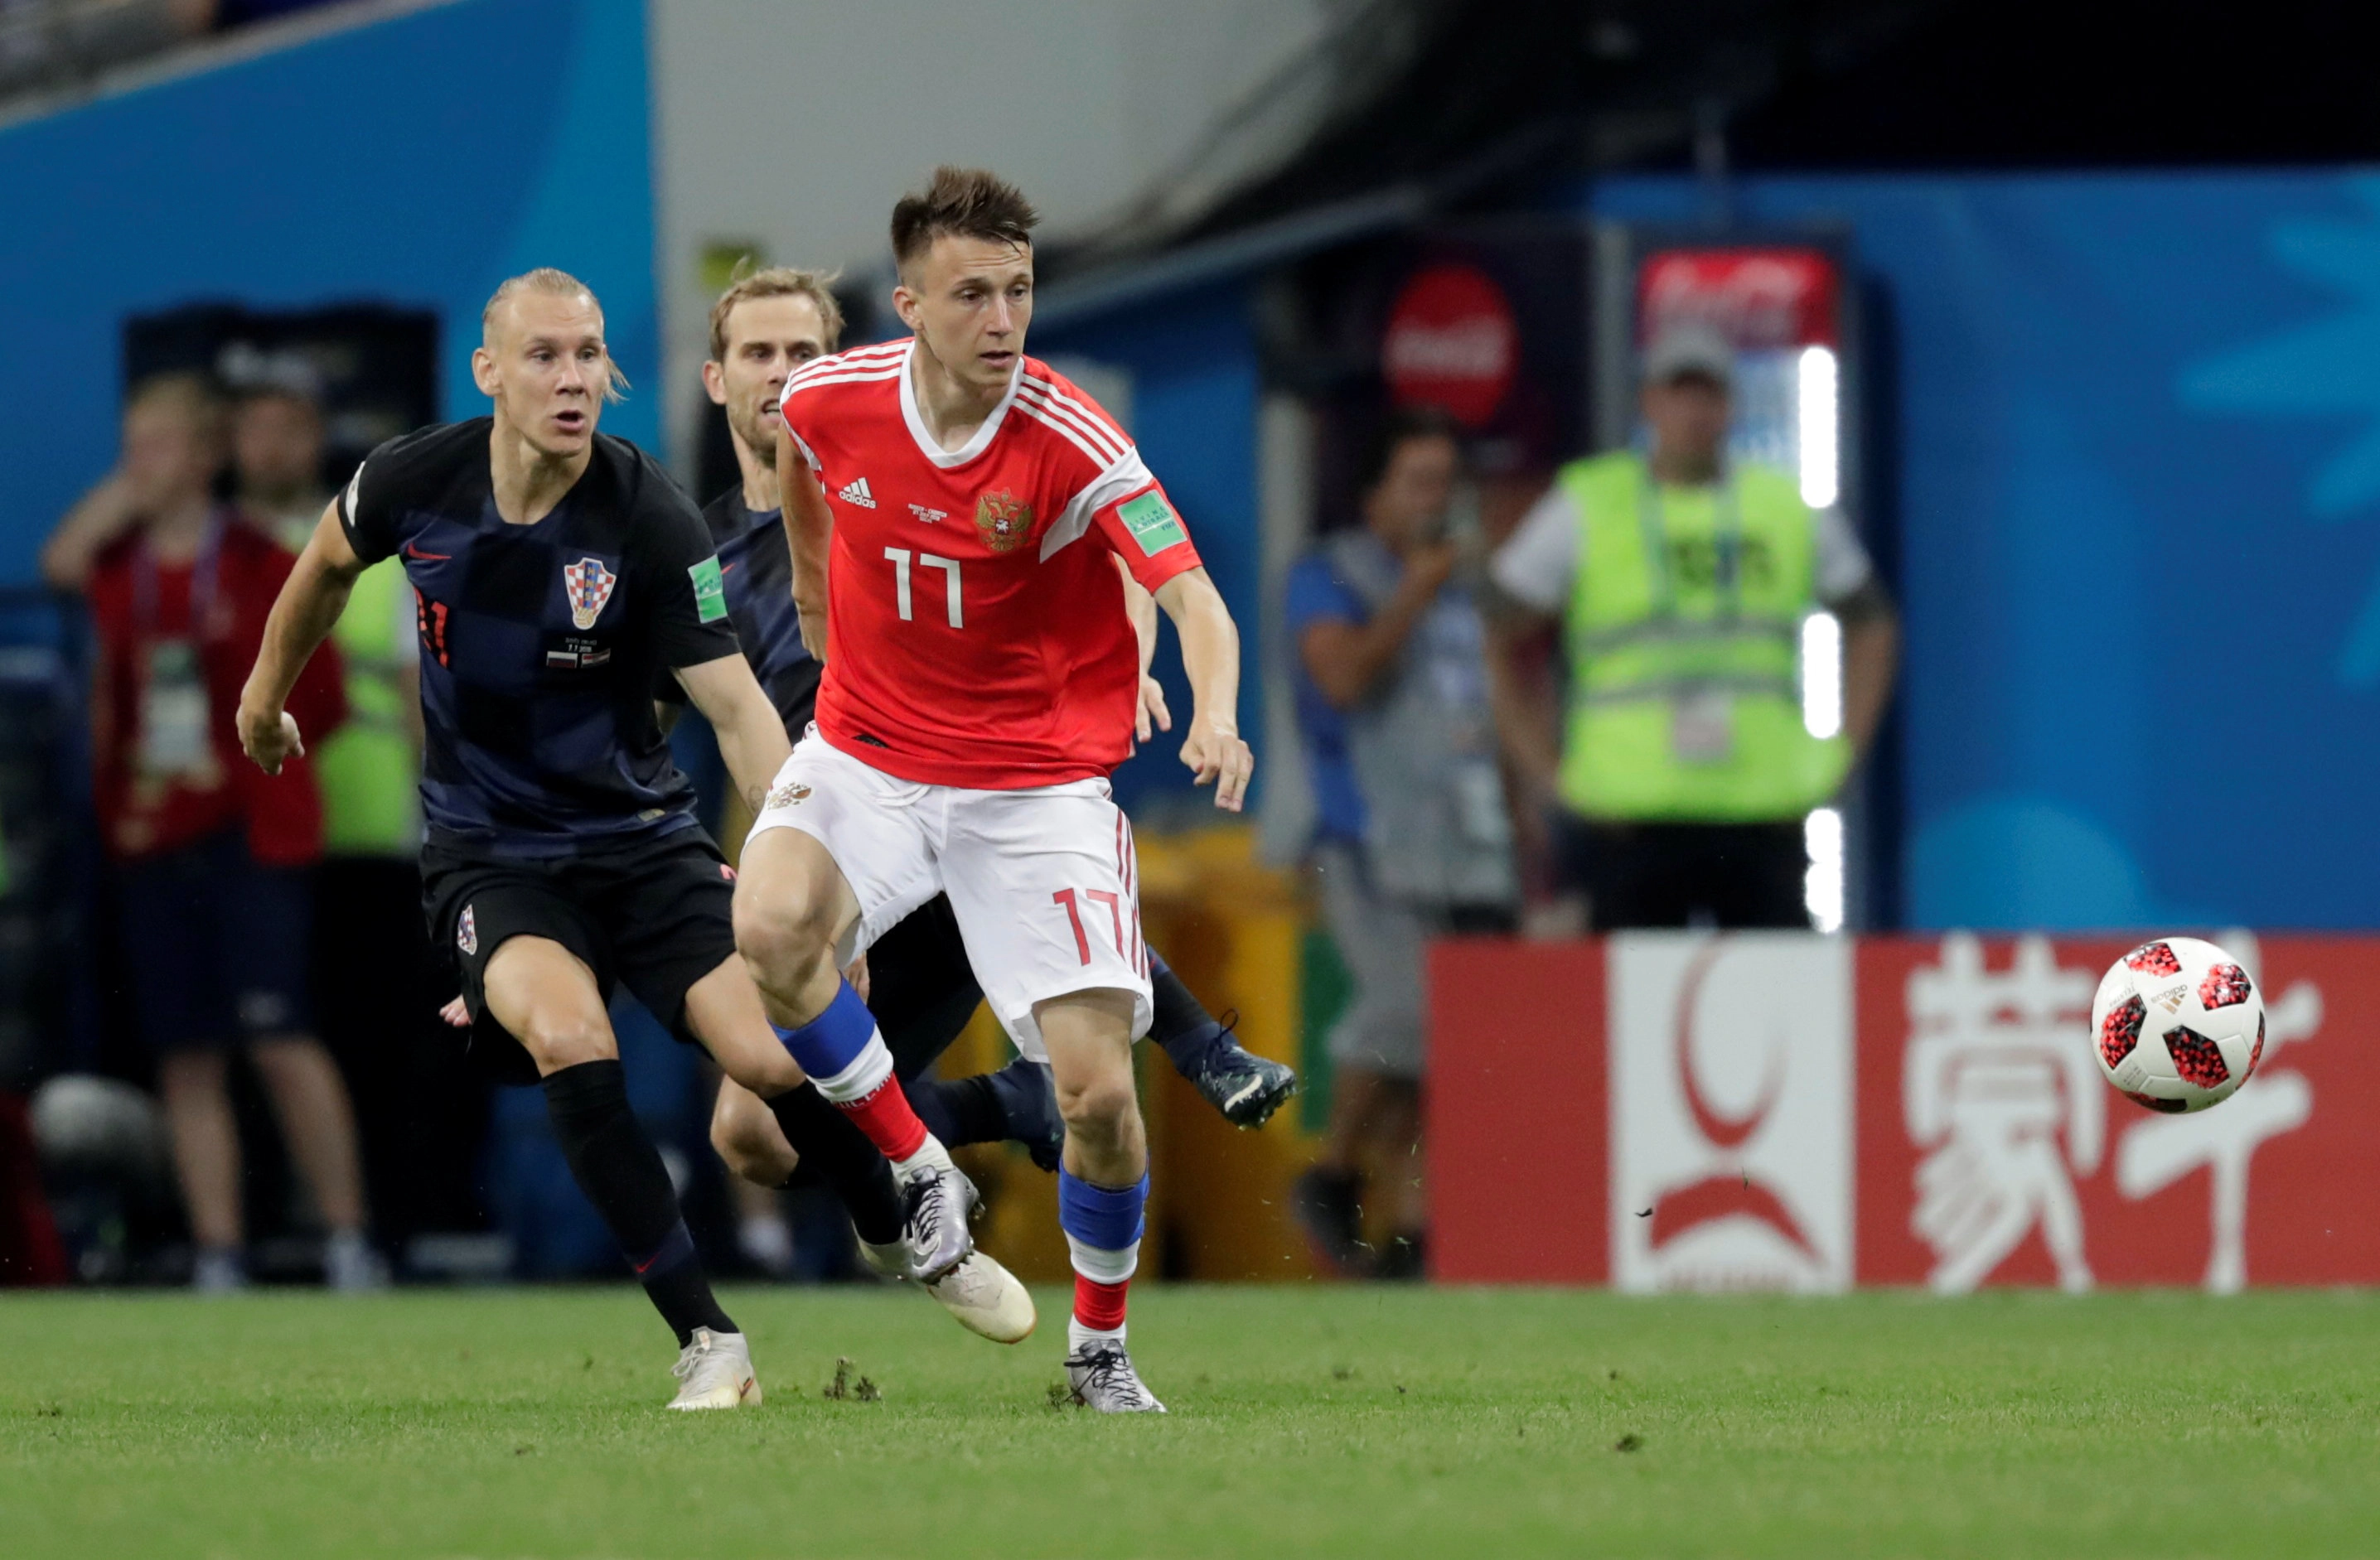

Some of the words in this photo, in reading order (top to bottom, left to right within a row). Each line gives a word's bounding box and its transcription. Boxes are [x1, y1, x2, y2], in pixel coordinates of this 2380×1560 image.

[839, 490, 877, 510] adidas
[884, 546, 964, 628] 17
[1052, 887, 1126, 967] 17
[2150, 984, 2188, 1004] adidas
